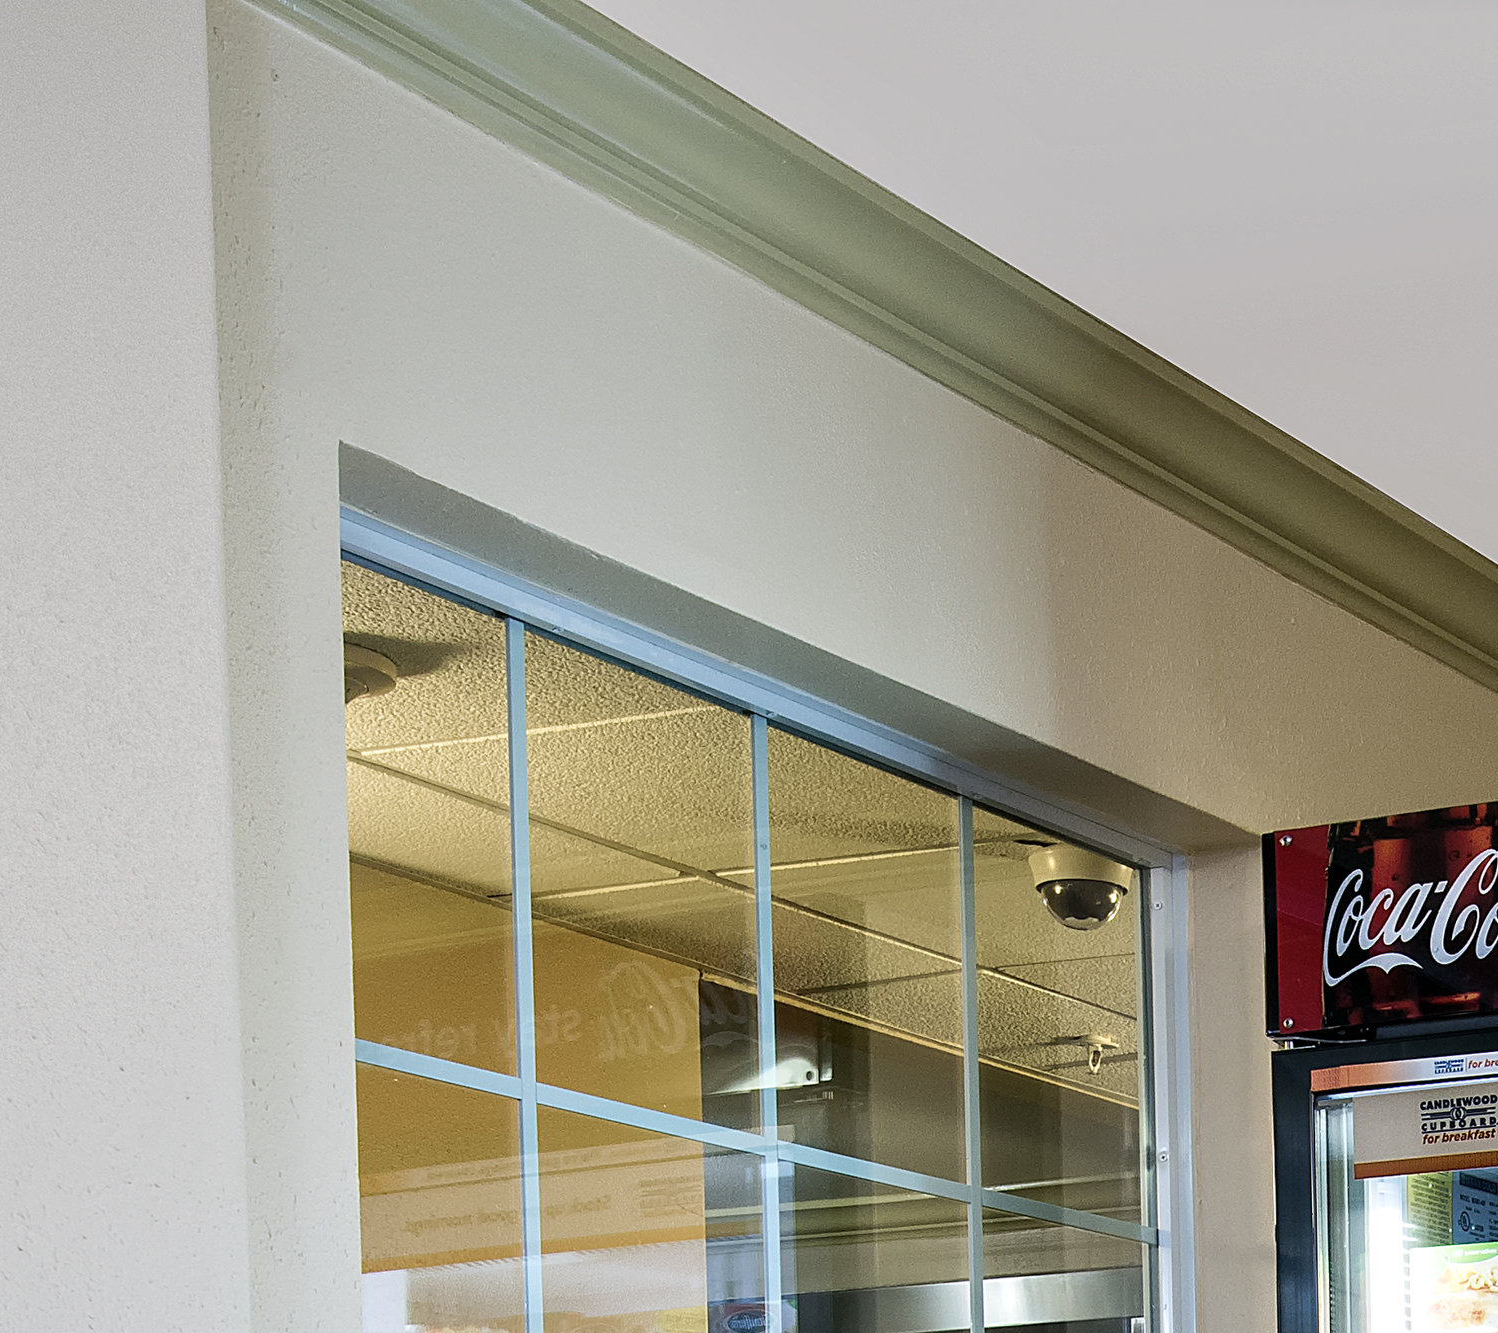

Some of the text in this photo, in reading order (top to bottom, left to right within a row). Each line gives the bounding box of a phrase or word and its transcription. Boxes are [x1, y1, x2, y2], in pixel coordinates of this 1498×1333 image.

[1468, 1057, 1482, 1070] for
[1420, 1094, 1498, 1111] CANDLEWOOD
[1421, 1117, 1498, 1131] CUPBOARD
[1422, 1127, 1495, 1145] for breakfast
